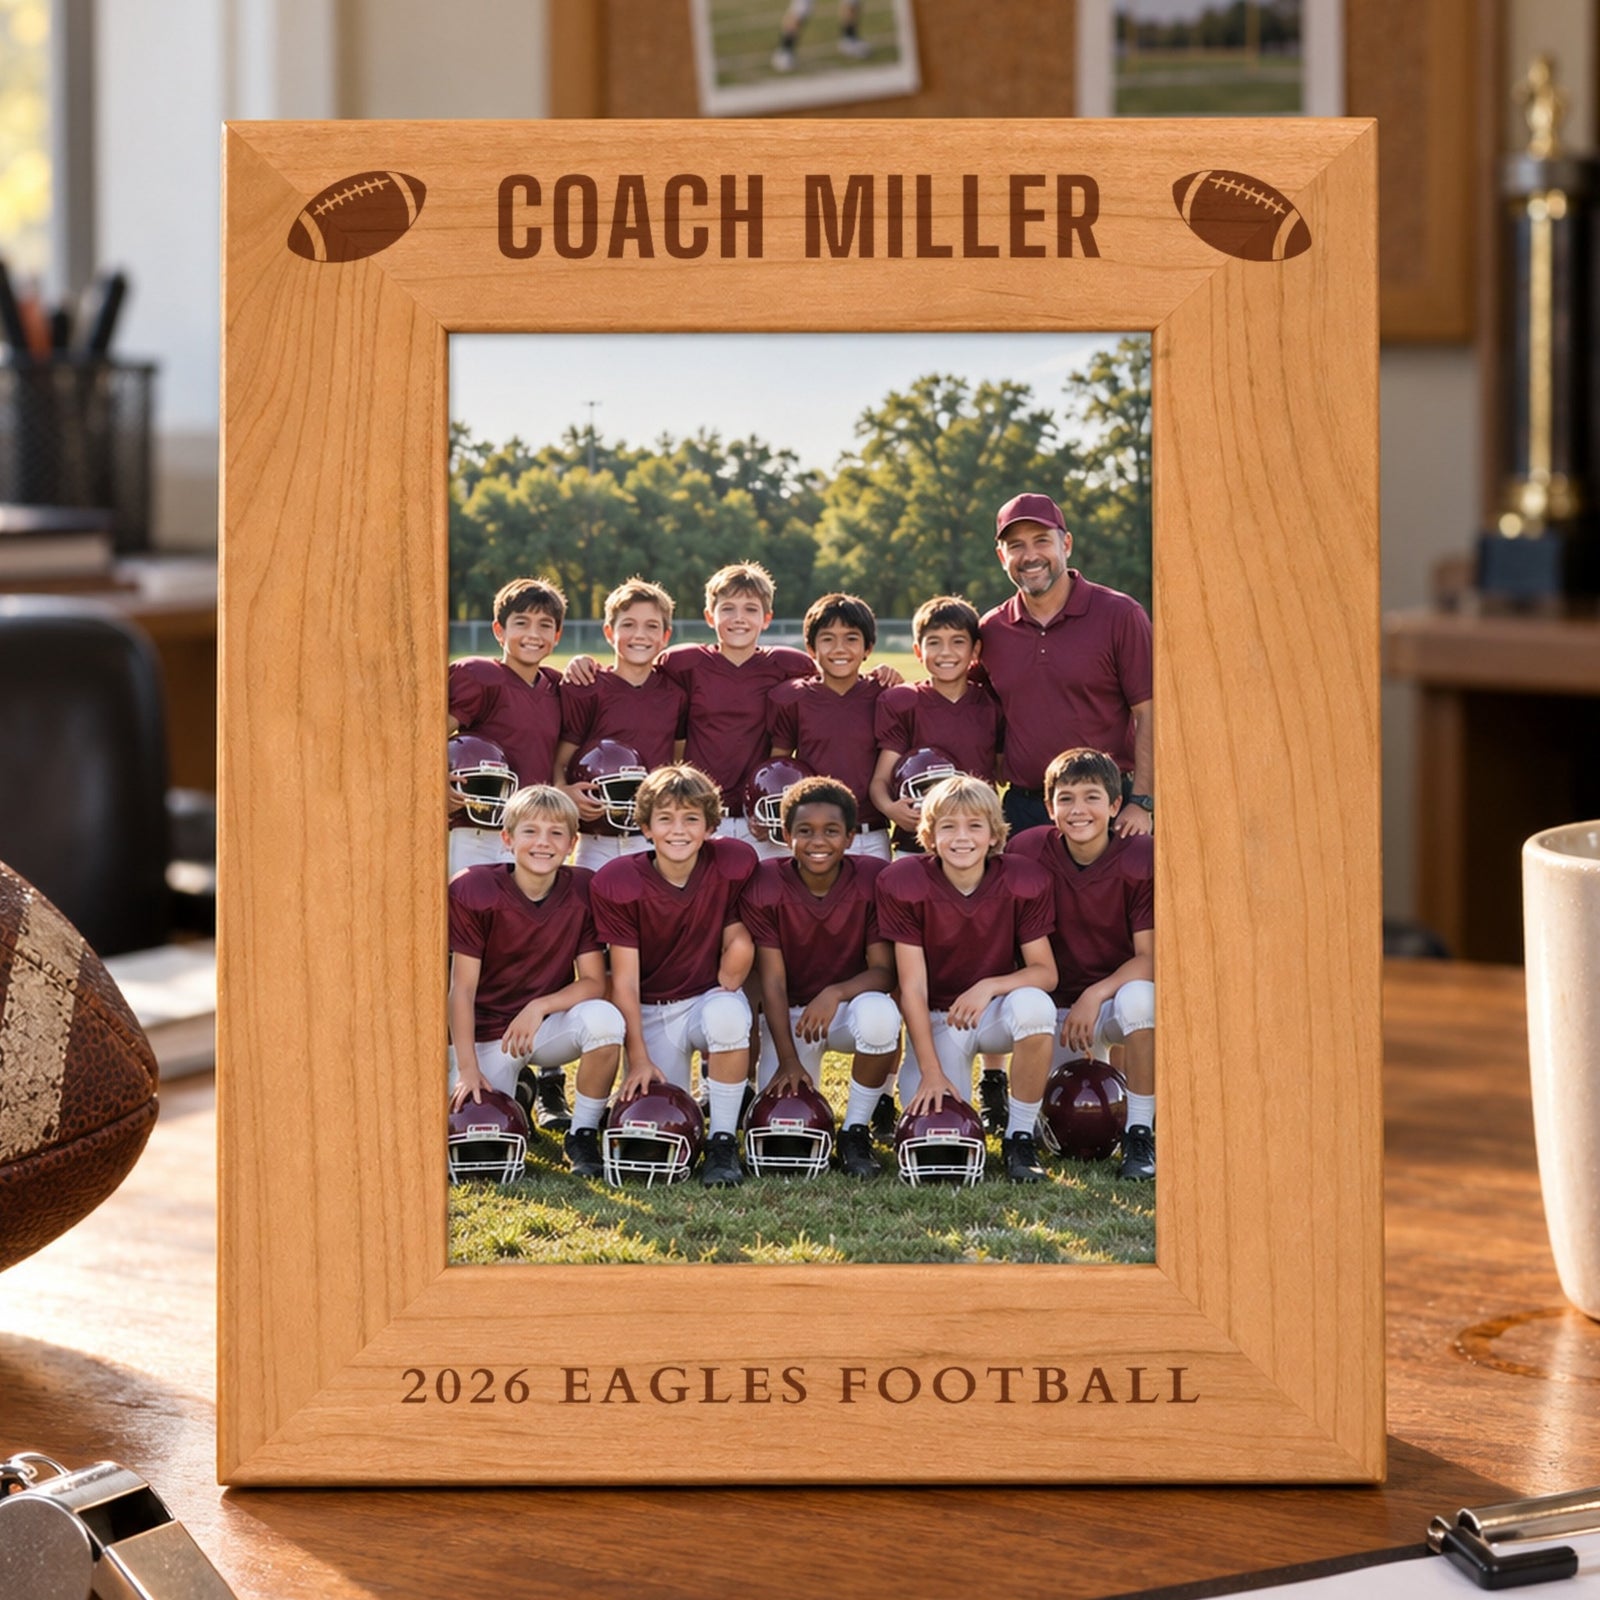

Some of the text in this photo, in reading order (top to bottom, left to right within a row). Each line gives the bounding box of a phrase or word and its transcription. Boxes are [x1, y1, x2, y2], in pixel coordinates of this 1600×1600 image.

[497, 174, 1101, 259] COACH MILLER
[401, 1366, 1201, 1404] 2026 EAGLES FOOTBALL
